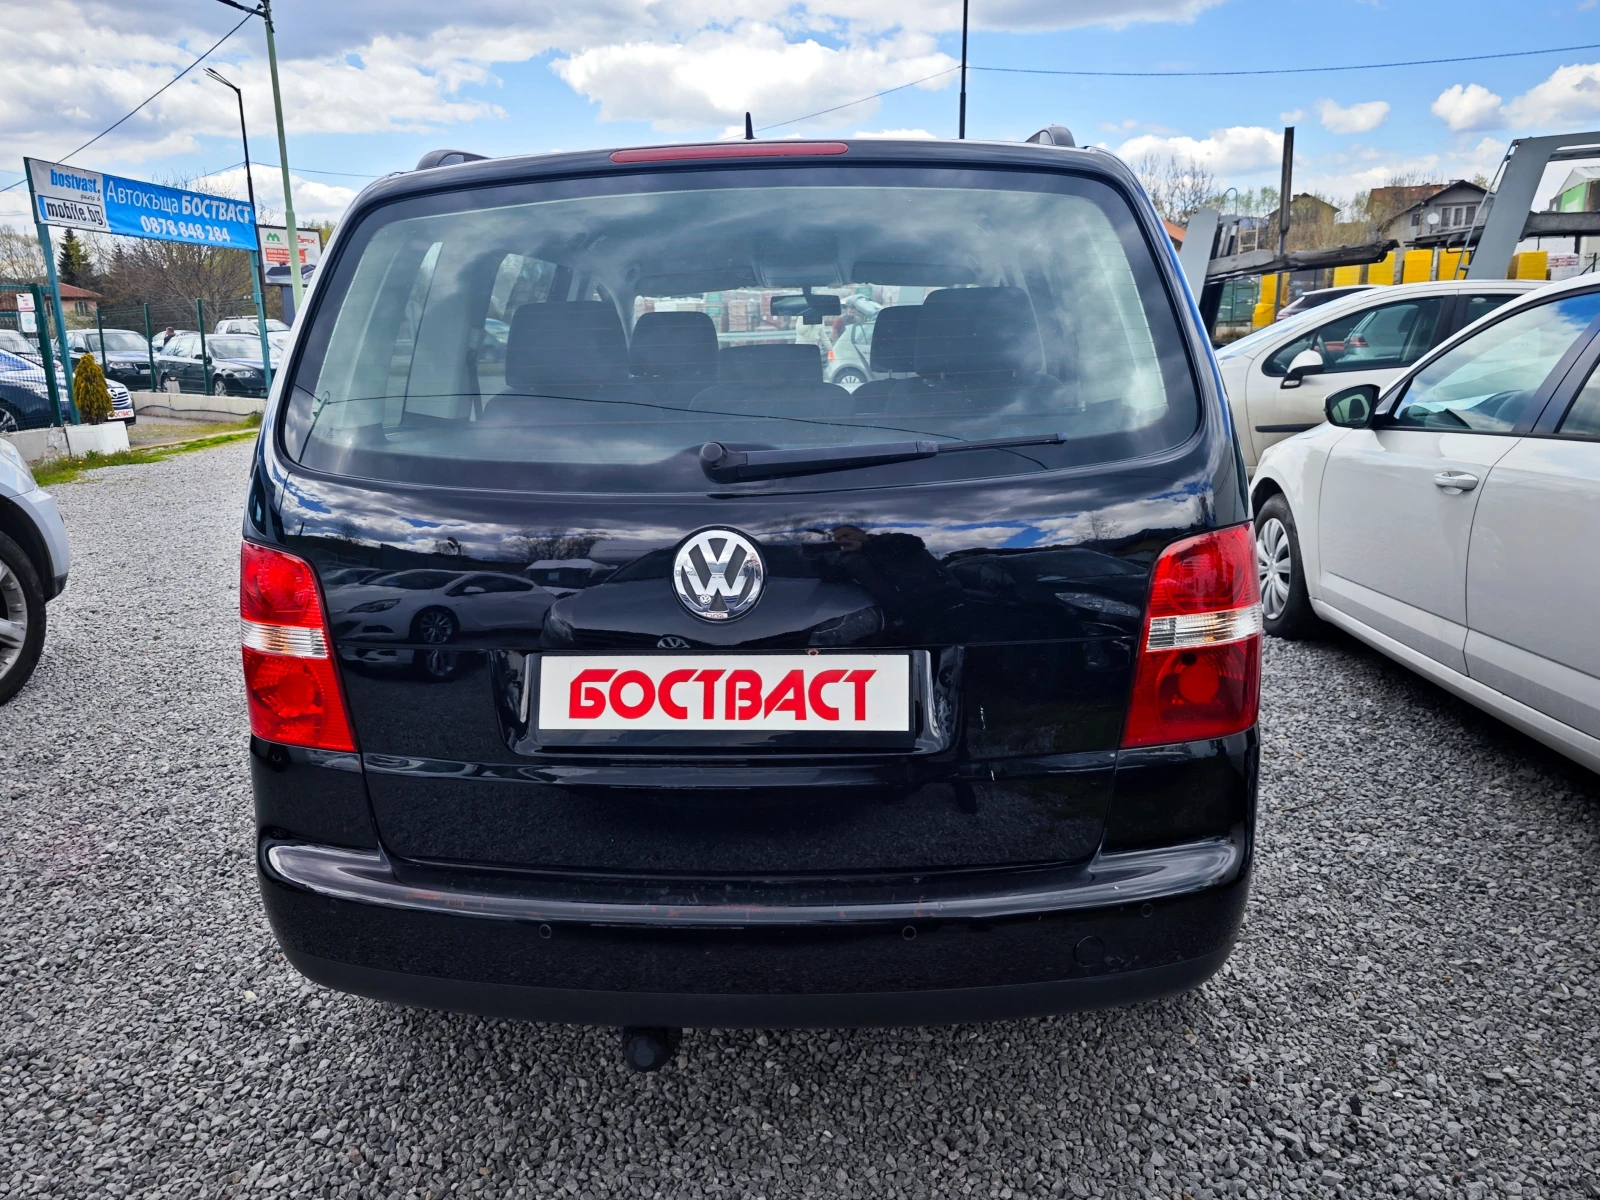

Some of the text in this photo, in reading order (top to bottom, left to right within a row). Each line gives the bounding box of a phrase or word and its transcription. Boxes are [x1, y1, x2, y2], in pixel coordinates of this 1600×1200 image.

[46, 202, 103, 226] mobile.bg
[106, 180, 251, 224] Автокъща БОСТВАСТ
[140, 215, 231, 243] 0878 848 284
[568, 668, 878, 721] БОСТВАСТ
